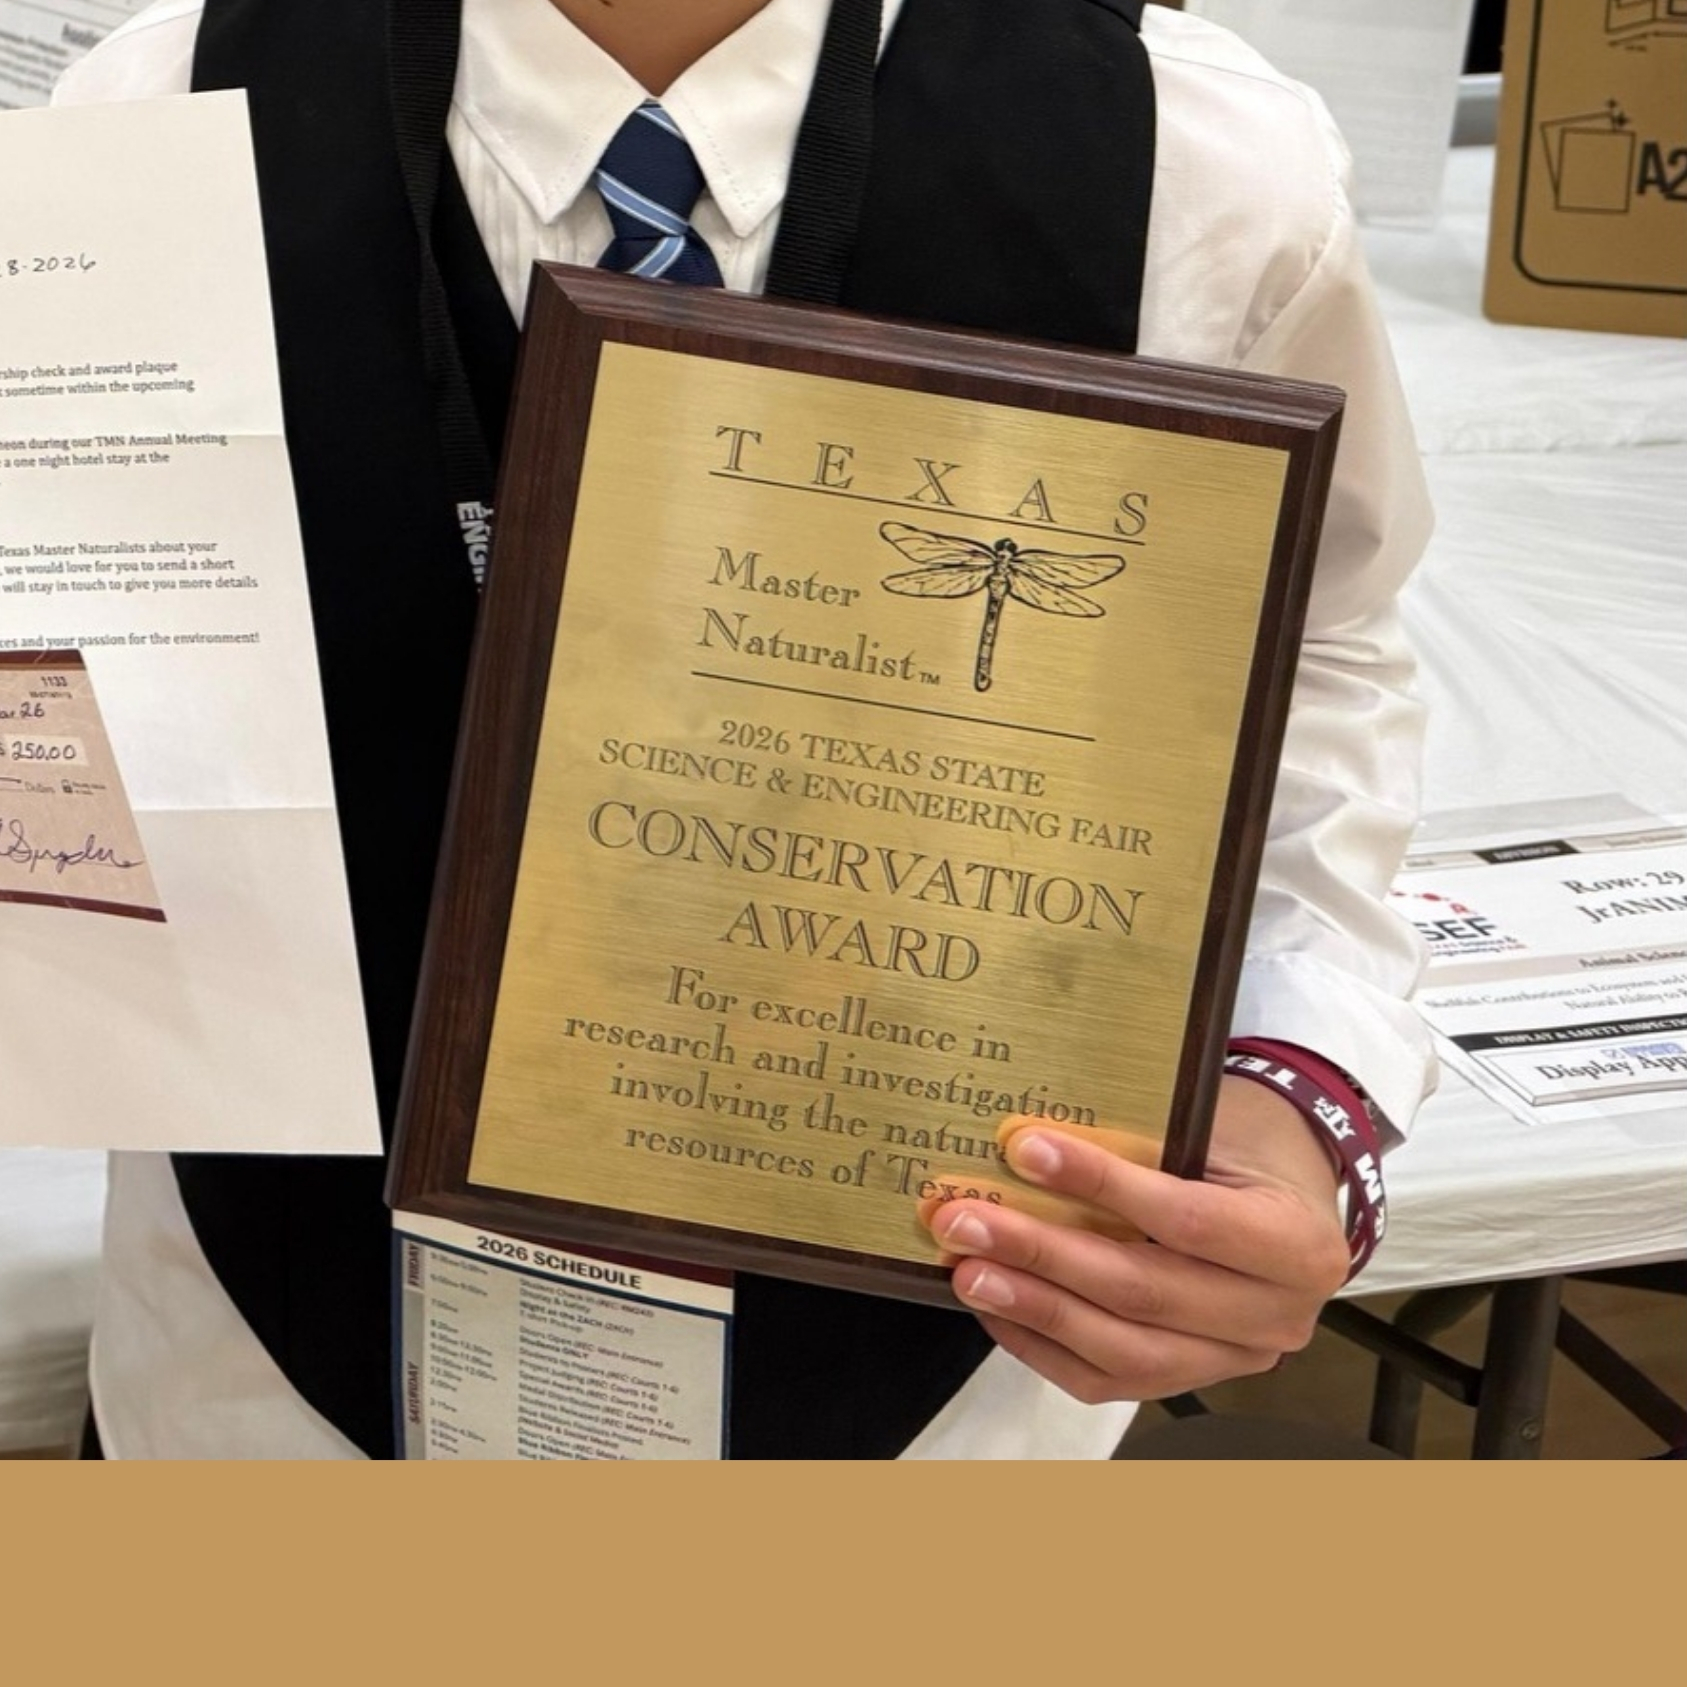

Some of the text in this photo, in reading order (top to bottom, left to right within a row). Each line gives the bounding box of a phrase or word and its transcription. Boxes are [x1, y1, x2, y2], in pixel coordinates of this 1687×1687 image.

[6, 383, 64, 397] sometime
[67, 381, 106, 394] within
[109, 380, 129, 392] the
[132, 378, 194, 394] upcoming
[31, 365, 66, 378] check
[68, 364, 90, 376] and
[93, 362, 132, 375] award
[135, 360, 178, 377] plaque
[716, 426, 1149, 537] TEXAS
[708, 546, 860, 607] Master
[21, 702, 46, 718] 26
[599, 738, 1153, 856] SCIENCE & ENGINEERING FAIR
[718, 720, 1046, 797] 2026 TEXAS STATE
[588, 800, 1145, 935] CONSERVATION
[1561, 869, 1687, 895] Row: 29
[718, 901, 980, 982] AWARD
[1579, 953, 1633, 969] Animal
[665, 964, 1011, 1062] For excellence in
[564, 1016, 1098, 1128] research and investigation
[611, 1061, 788, 1131] involving
[802, 1092, 868, 1138] the
[1535, 1053, 1687, 1081] Display App
[625, 1125, 1002, 1205] resources of Texas
[476, 1235, 642, 1289] 2026 SCHEDULE
